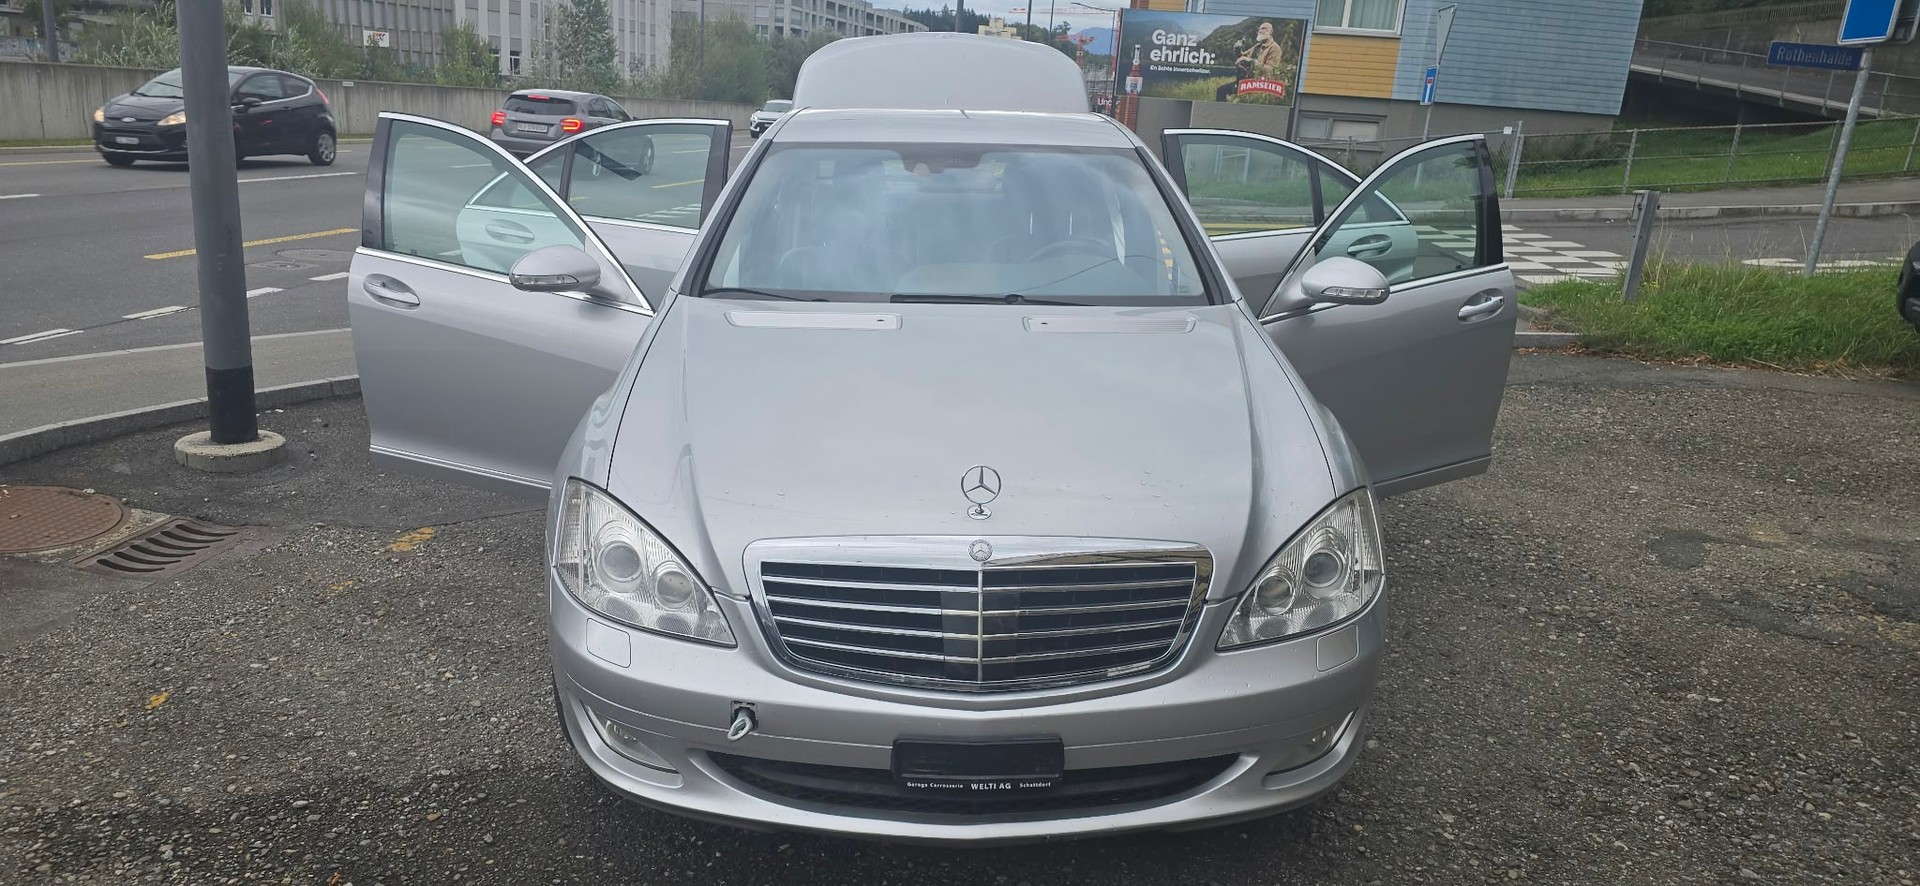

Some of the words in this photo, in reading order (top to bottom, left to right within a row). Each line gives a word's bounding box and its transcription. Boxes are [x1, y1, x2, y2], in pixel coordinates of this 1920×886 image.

[1152, 29, 1197, 47] Ganz
[1150, 46, 1216, 65] ehrlich:
[1776, 46, 1853, 66] Rothenhalde
[1240, 81, 1282, 94] RAMSEIER
[906, 781, 928, 789] Garage
[998, 782, 1011, 790] AG
